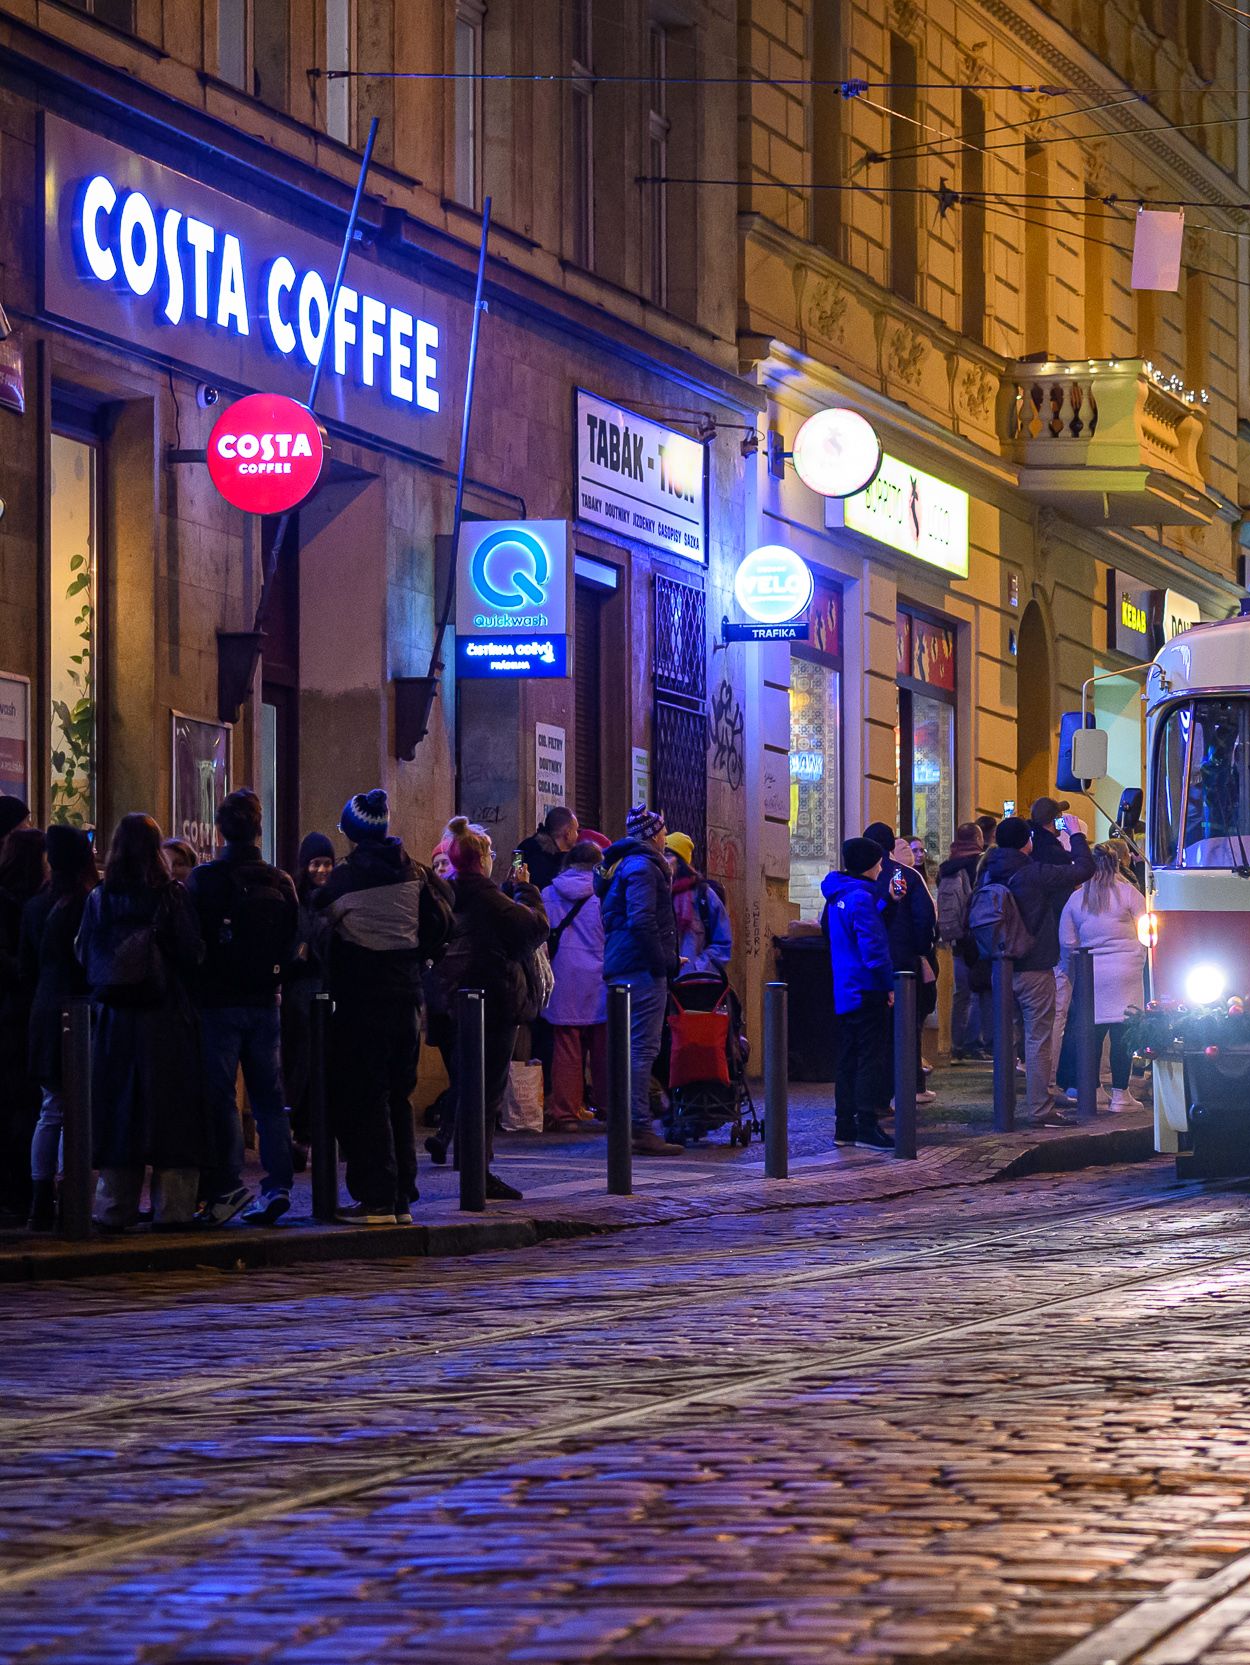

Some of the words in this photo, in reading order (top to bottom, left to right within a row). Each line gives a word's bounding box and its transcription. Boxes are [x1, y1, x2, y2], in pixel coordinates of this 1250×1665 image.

[82, 175, 249, 336] COSTA
[267, 256, 440, 413] COFFEE
[217, 433, 313, 461] COSTA
[587, 413, 644, 483] TABÁK
[238, 462, 292, 474] COFFEE
[581, 493, 602, 514] TABÁKY
[658, 522, 682, 543] ČASOPISY
[684, 533, 700, 550] SAZKA
[474, 614, 548, 627] Quickwash
[1121, 601, 1147, 634] KEBAB
[752, 629, 796, 639] TRAFIKA
[551, 782, 564, 796] COLA
